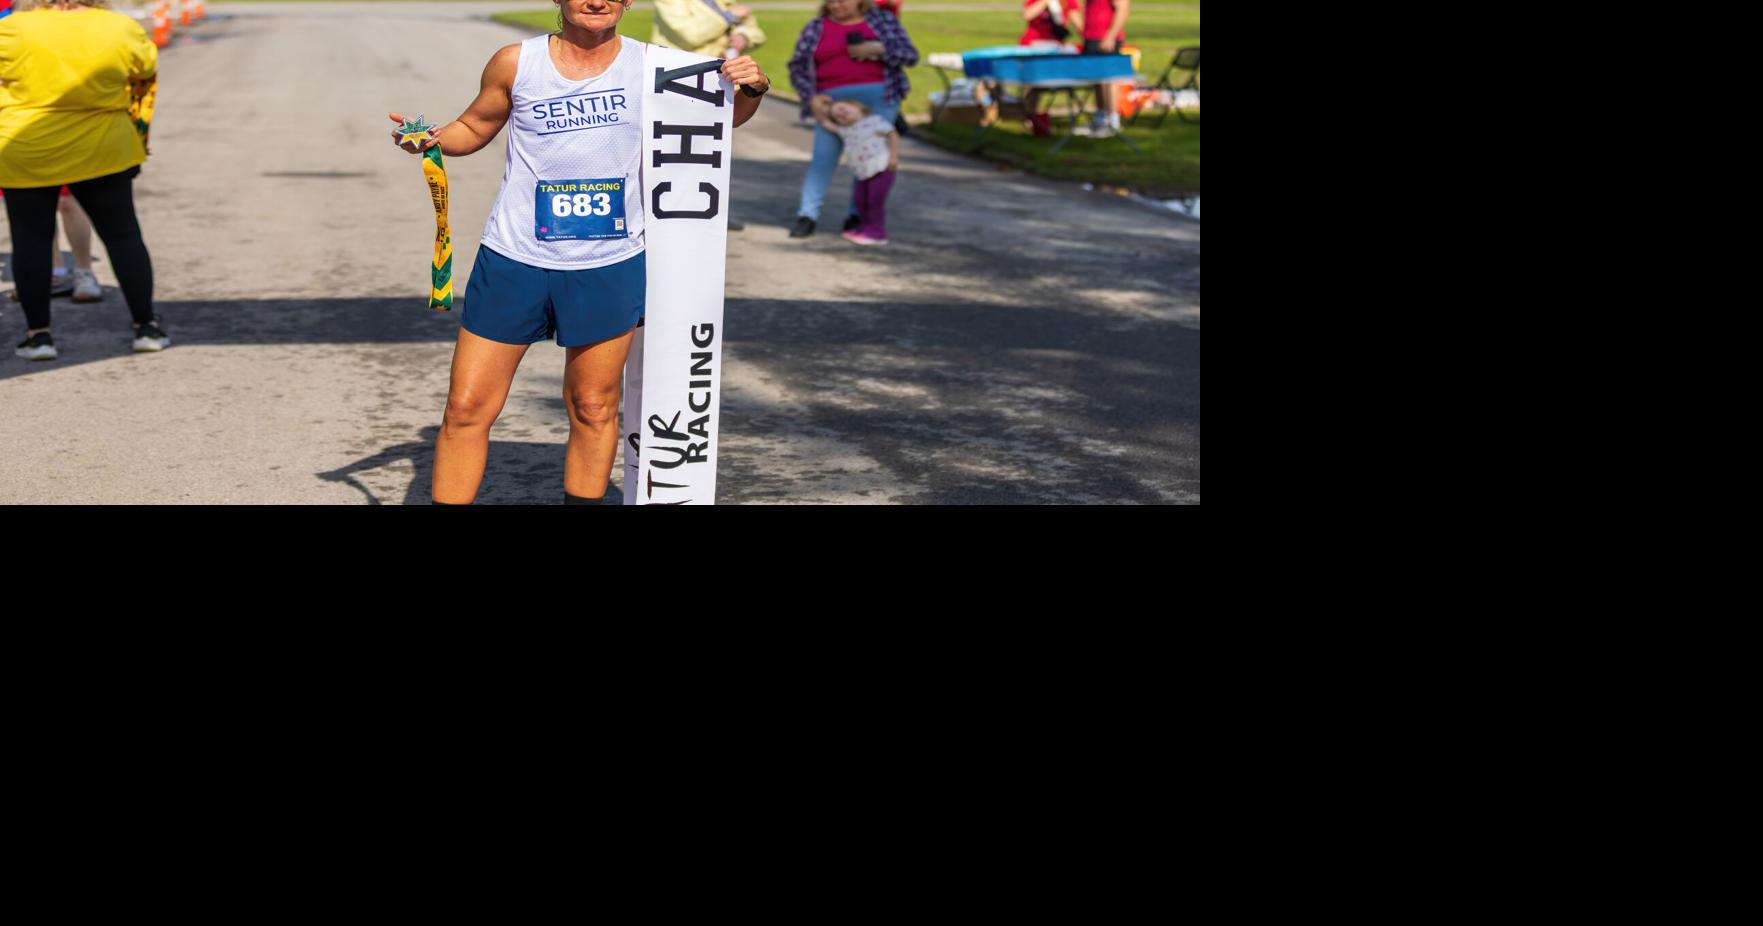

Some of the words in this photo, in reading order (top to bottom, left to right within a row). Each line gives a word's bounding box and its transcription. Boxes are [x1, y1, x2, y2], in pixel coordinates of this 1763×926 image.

[532, 94, 627, 119] SENTIR
[546, 113, 619, 129] RUNNING
[652, 46, 725, 219] CHA
[540, 184, 577, 192] TATUR
[579, 183, 621, 191] RACING
[552, 192, 611, 217] 683
[687, 323, 714, 463] RACING
[645, 410, 693, 505] TUR
